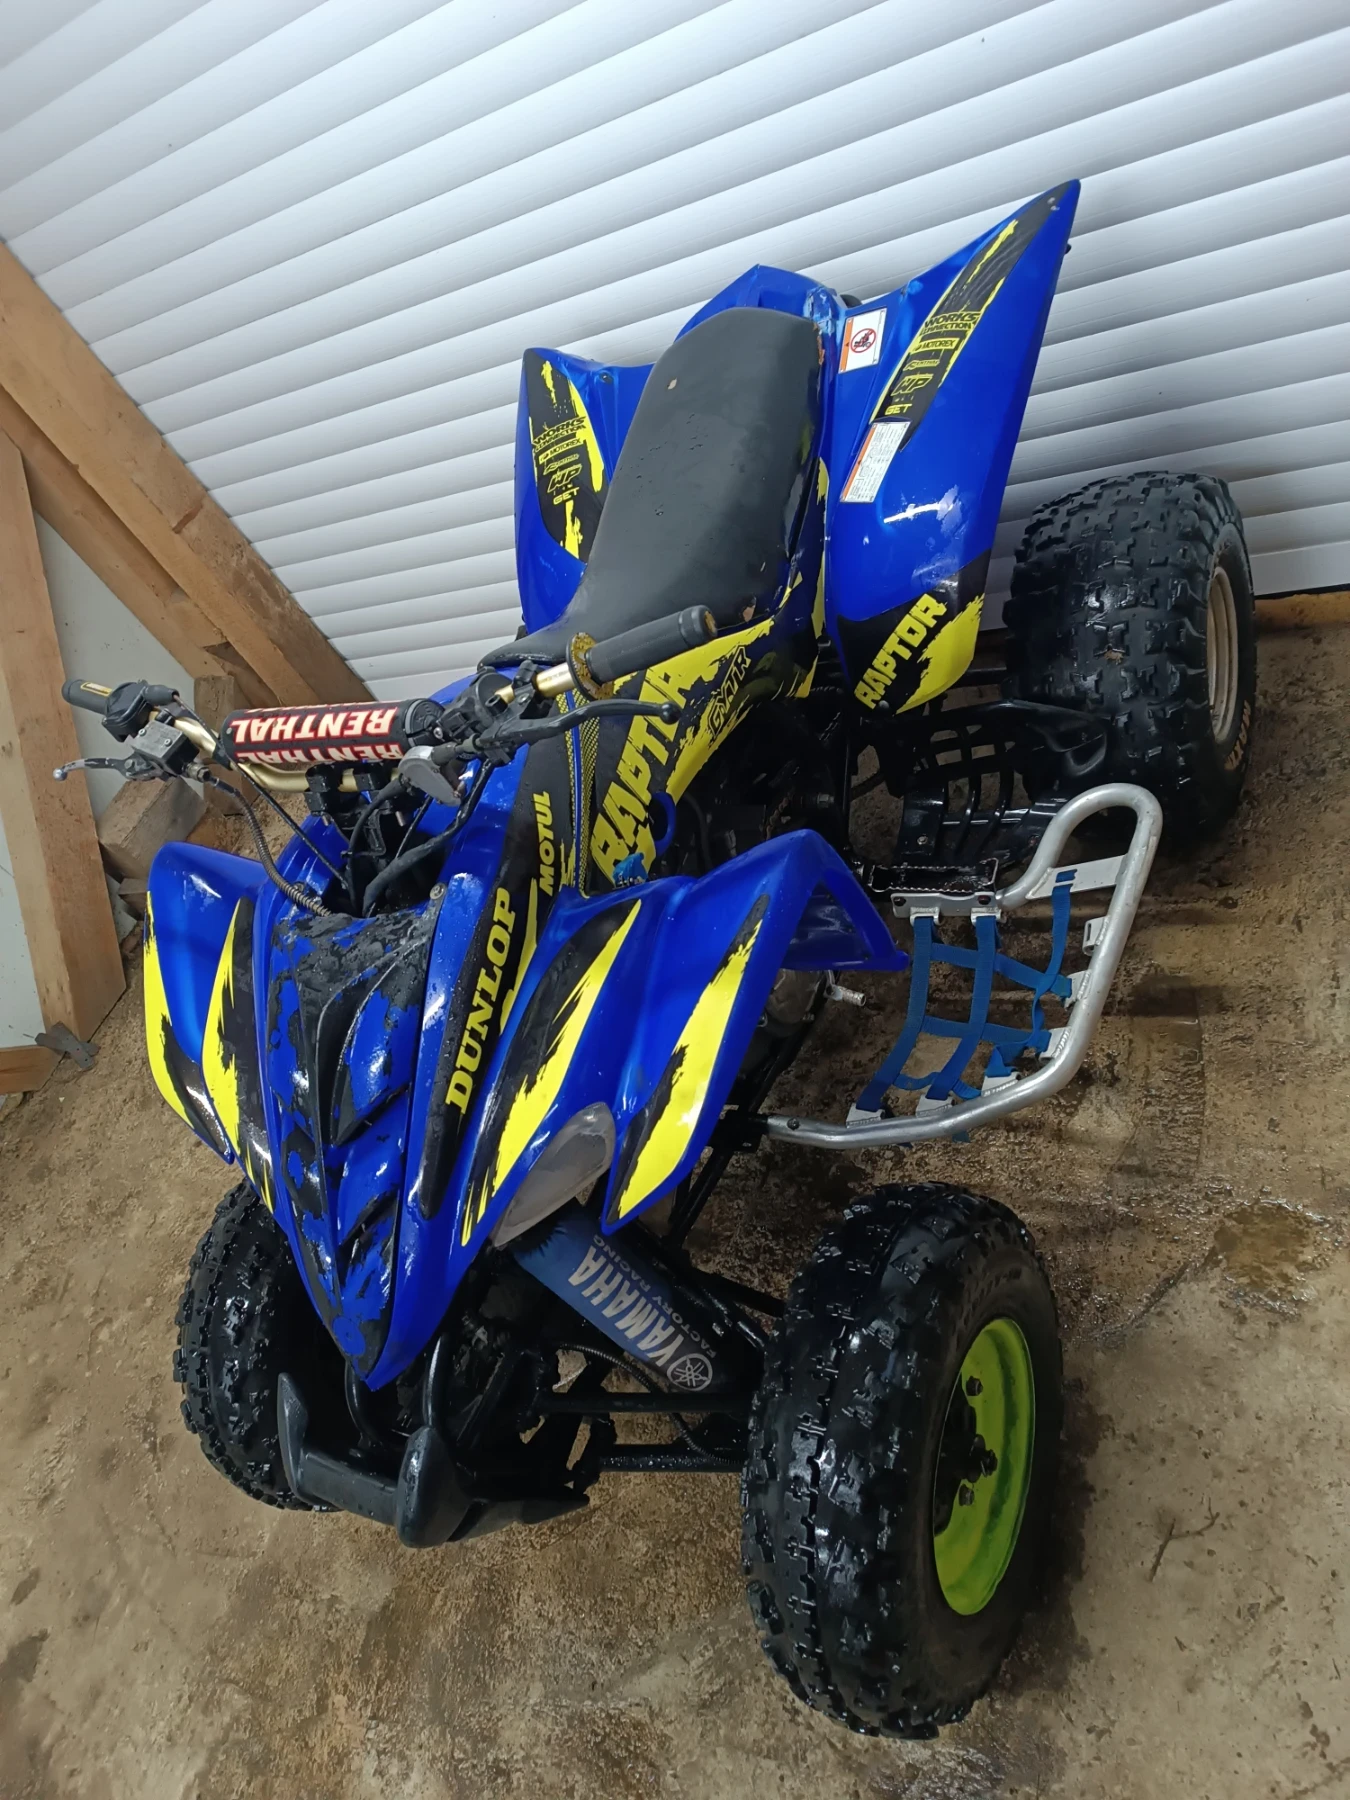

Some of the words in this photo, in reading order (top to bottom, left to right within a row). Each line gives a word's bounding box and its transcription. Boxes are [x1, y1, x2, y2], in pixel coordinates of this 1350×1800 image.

[924, 312, 980, 328] WORKS
[922, 340, 956, 349] MOTOREX
[891, 374, 934, 396] WP
[885, 403, 912, 415] GET
[533, 416, 587, 444] WORKS
[550, 438, 582, 453] MOTOREX
[547, 464, 582, 493] WP
[553, 487, 580, 505] GET
[853, 593, 947, 709] RAPTOR
[709, 646, 751, 737] GYTR
[230, 706, 398, 744] RENTHAL
[533, 790, 555, 897] MOTUL
[445, 887, 516, 1115] DUNLOP
[593, 1234, 651, 1292] RACING
[568, 1245, 684, 1367] YAMAHA
[652, 1295, 717, 1358] FACTORY
